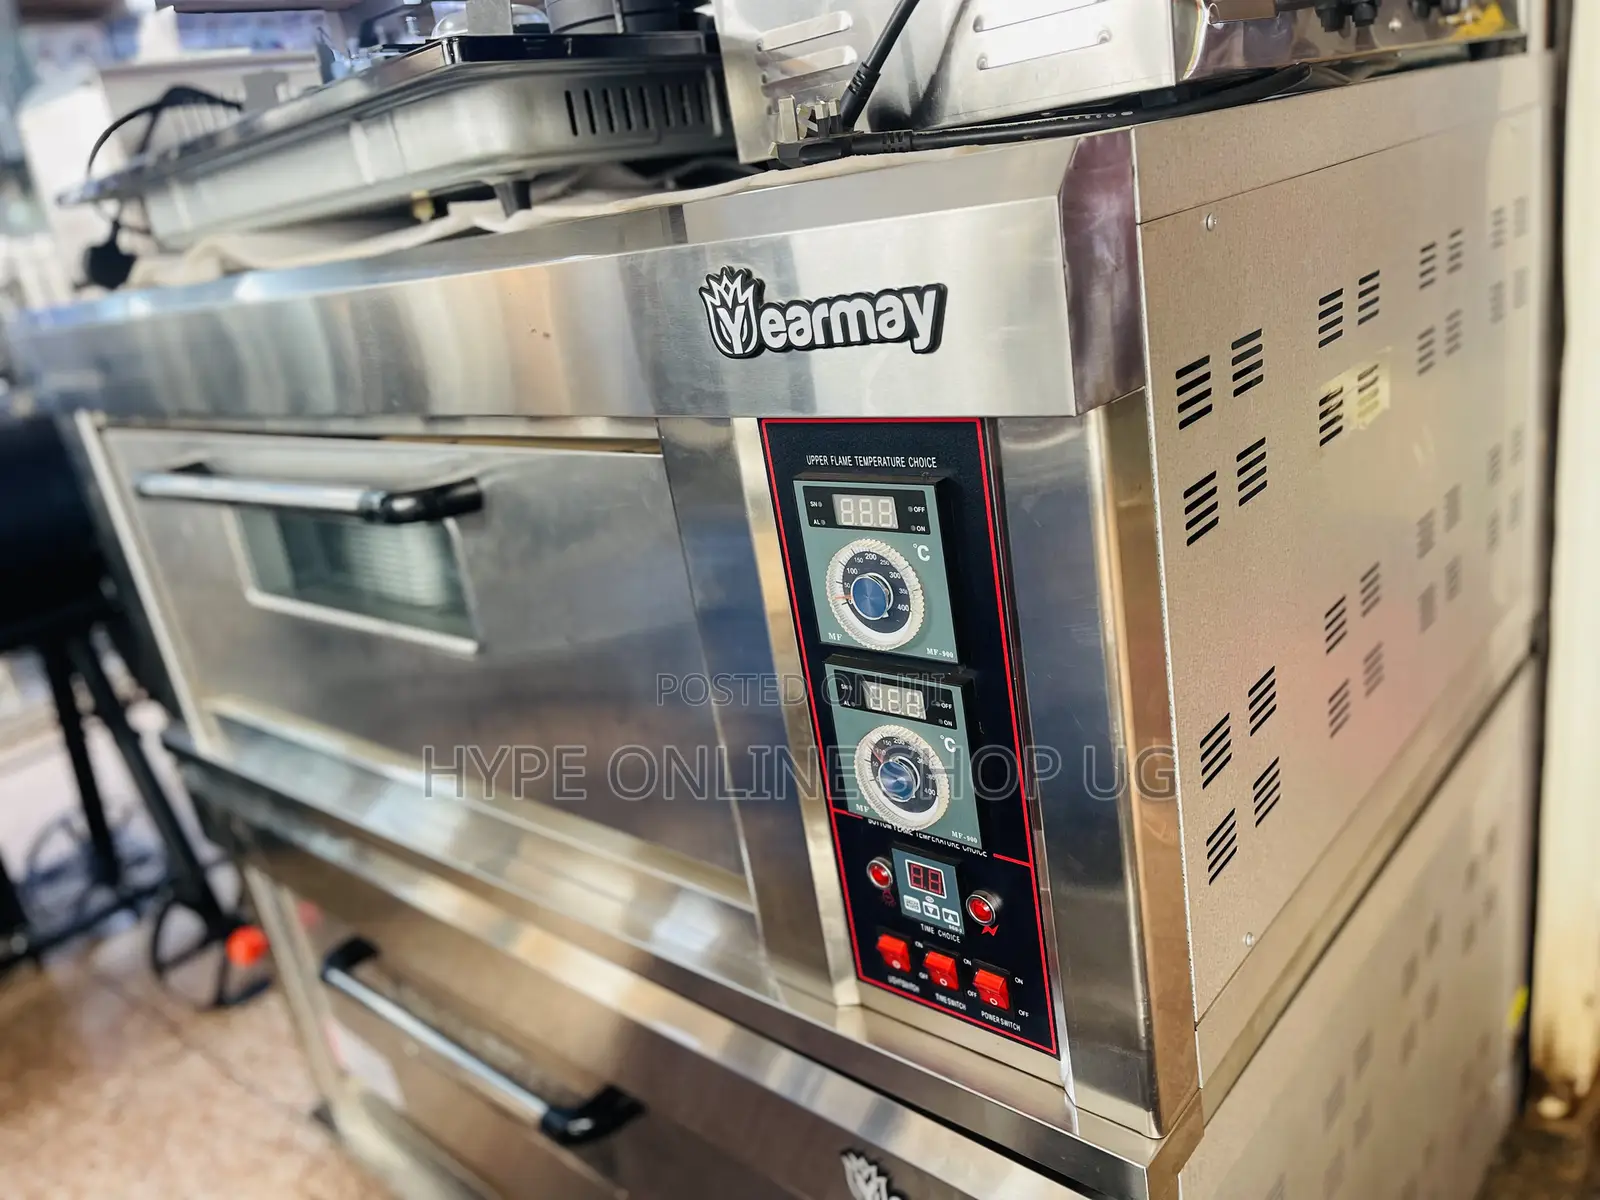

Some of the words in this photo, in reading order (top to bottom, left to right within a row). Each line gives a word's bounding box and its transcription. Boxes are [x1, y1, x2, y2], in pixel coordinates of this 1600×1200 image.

[704, 272, 945, 357] Yearmay
[805, 454, 829, 466] UPPER
[830, 455, 853, 467] FLAME
[853, 455, 906, 468] TEMPERATURE
[908, 456, 938, 469] CHOICE
[864, 552, 877, 561] 200
[846, 567, 858, 575] 100
[888, 571, 901, 579] 300
[897, 604, 909, 612] 400
[828, 632, 843, 641] MF
[940, 702, 952, 710] OFF
[943, 719, 953, 727] ON
[855, 803, 870, 813] MF
[920, 923, 935, 935] TIME
[937, 929, 961, 944] CHOICE
[914, 940, 924, 949] ON
[963, 958, 972, 966] ON
[1014, 976, 1024, 985] ON
[967, 989, 978, 998] OFF
[1018, 1008, 1030, 1018] OFF
